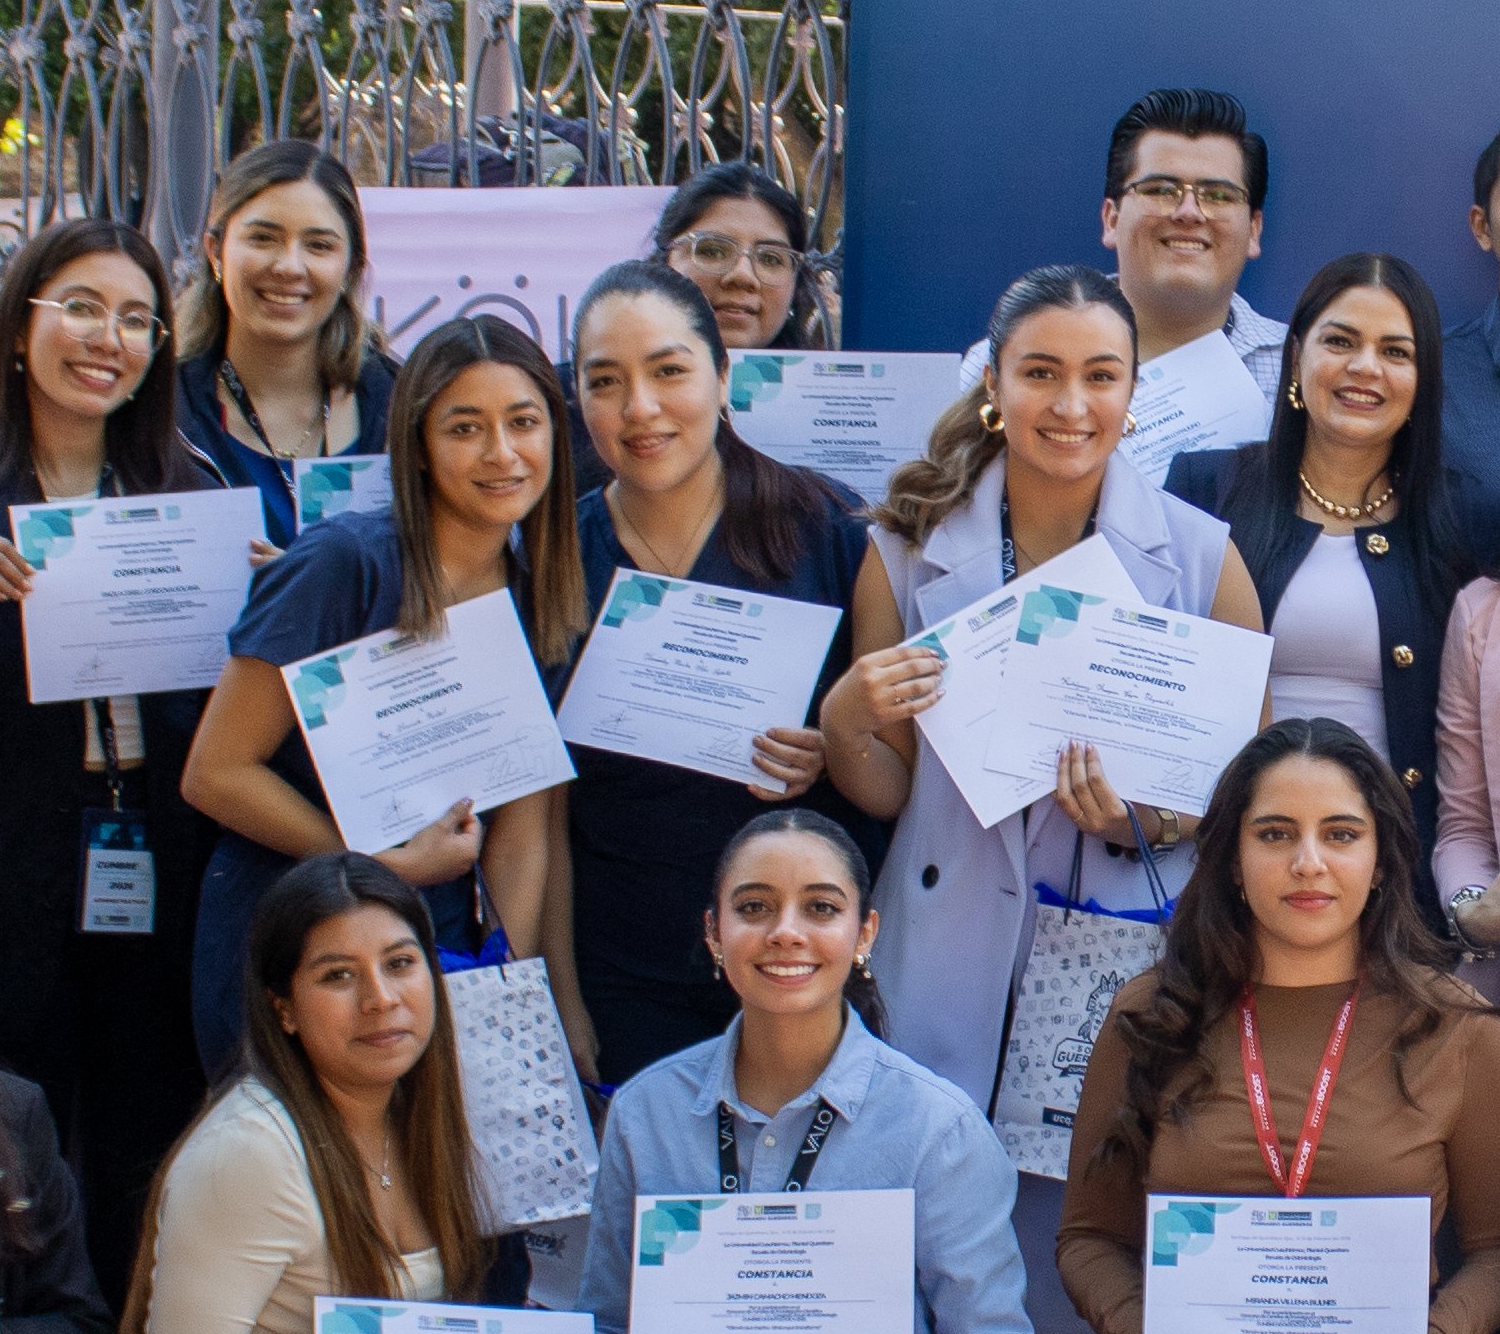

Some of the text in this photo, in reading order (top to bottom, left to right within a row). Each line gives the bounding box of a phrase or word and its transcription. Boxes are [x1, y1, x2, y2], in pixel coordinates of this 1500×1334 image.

[813, 419, 878, 429] CONSTANCIA
[1002, 538, 1016, 579] VALO
[661, 642, 749, 666] RECONOCIMIENTO
[1089, 662, 1187, 692] RECONOCIMIENTO
[375, 682, 463, 720] RECONOCIMIENTO
[1337, 1001, 1351, 1031] BOOST
[1252, 1073, 1264, 1105] BOOST
[1317, 1067, 1332, 1101] BOOST
[801, 1110, 833, 1154] VALO
[1267, 1144, 1280, 1178] BOOST
[1297, 1140, 1311, 1175] BOOST
[738, 1270, 813, 1279] CONSTANCIA
[1252, 1275, 1329, 1285] CONSTANCIA
